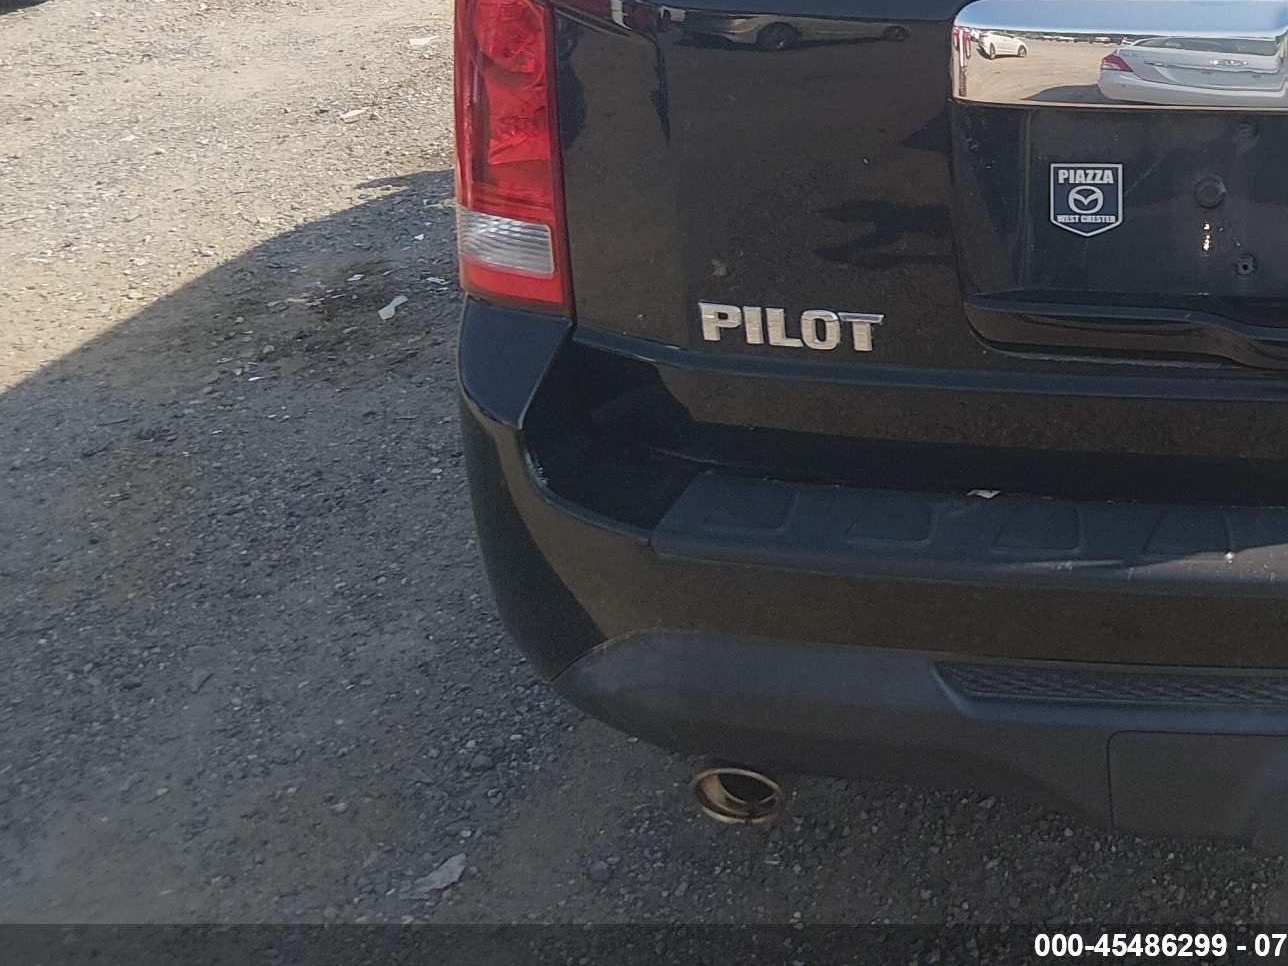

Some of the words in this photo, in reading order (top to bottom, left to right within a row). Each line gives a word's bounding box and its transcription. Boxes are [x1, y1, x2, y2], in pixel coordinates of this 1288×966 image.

[1057, 169, 1114, 184] PIAZZA
[1056, 215, 1080, 223] WEST
[1080, 215, 1116, 223] CHESTER
[698, 302, 885, 352] PILOT
